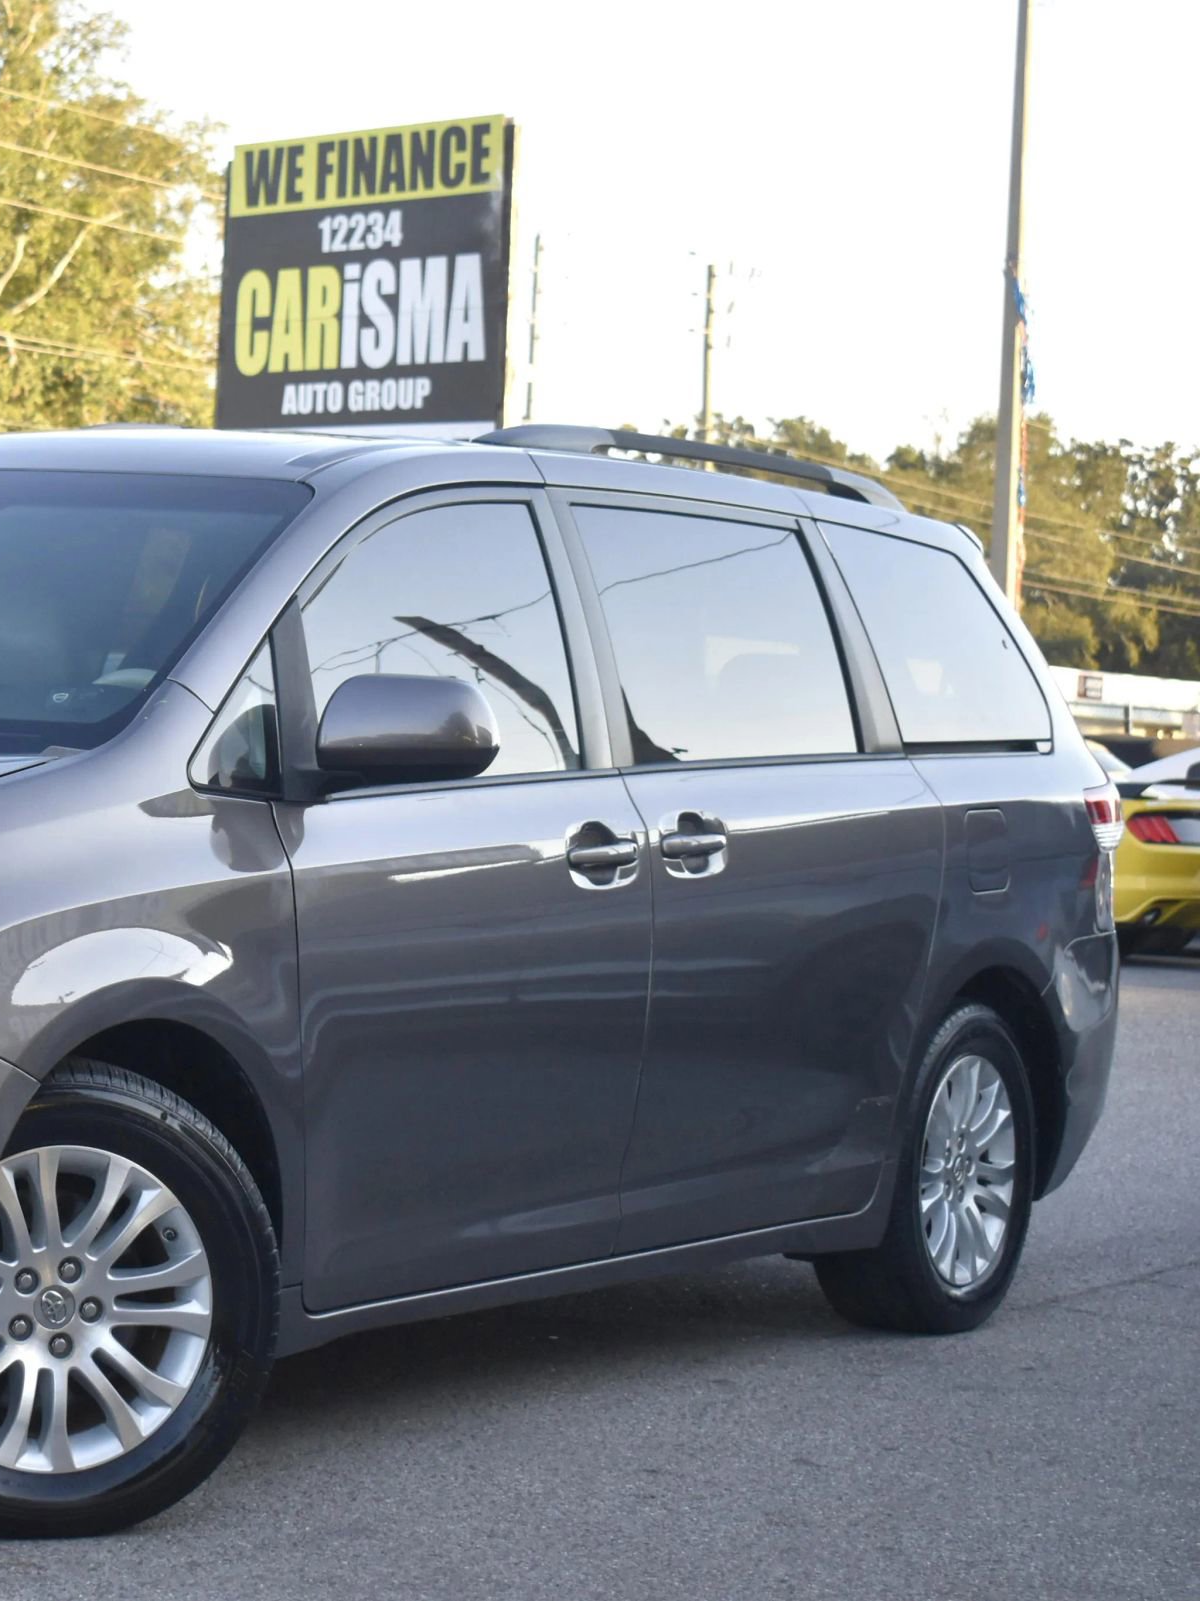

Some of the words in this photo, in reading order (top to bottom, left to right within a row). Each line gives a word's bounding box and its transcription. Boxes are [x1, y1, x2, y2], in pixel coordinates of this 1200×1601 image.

[244, 144, 304, 209] WE
[315, 122, 491, 201] FINANCE
[317, 209, 403, 253] 12234
[281, 381, 344, 415] AUTO
[347, 377, 432, 412] GROUP
